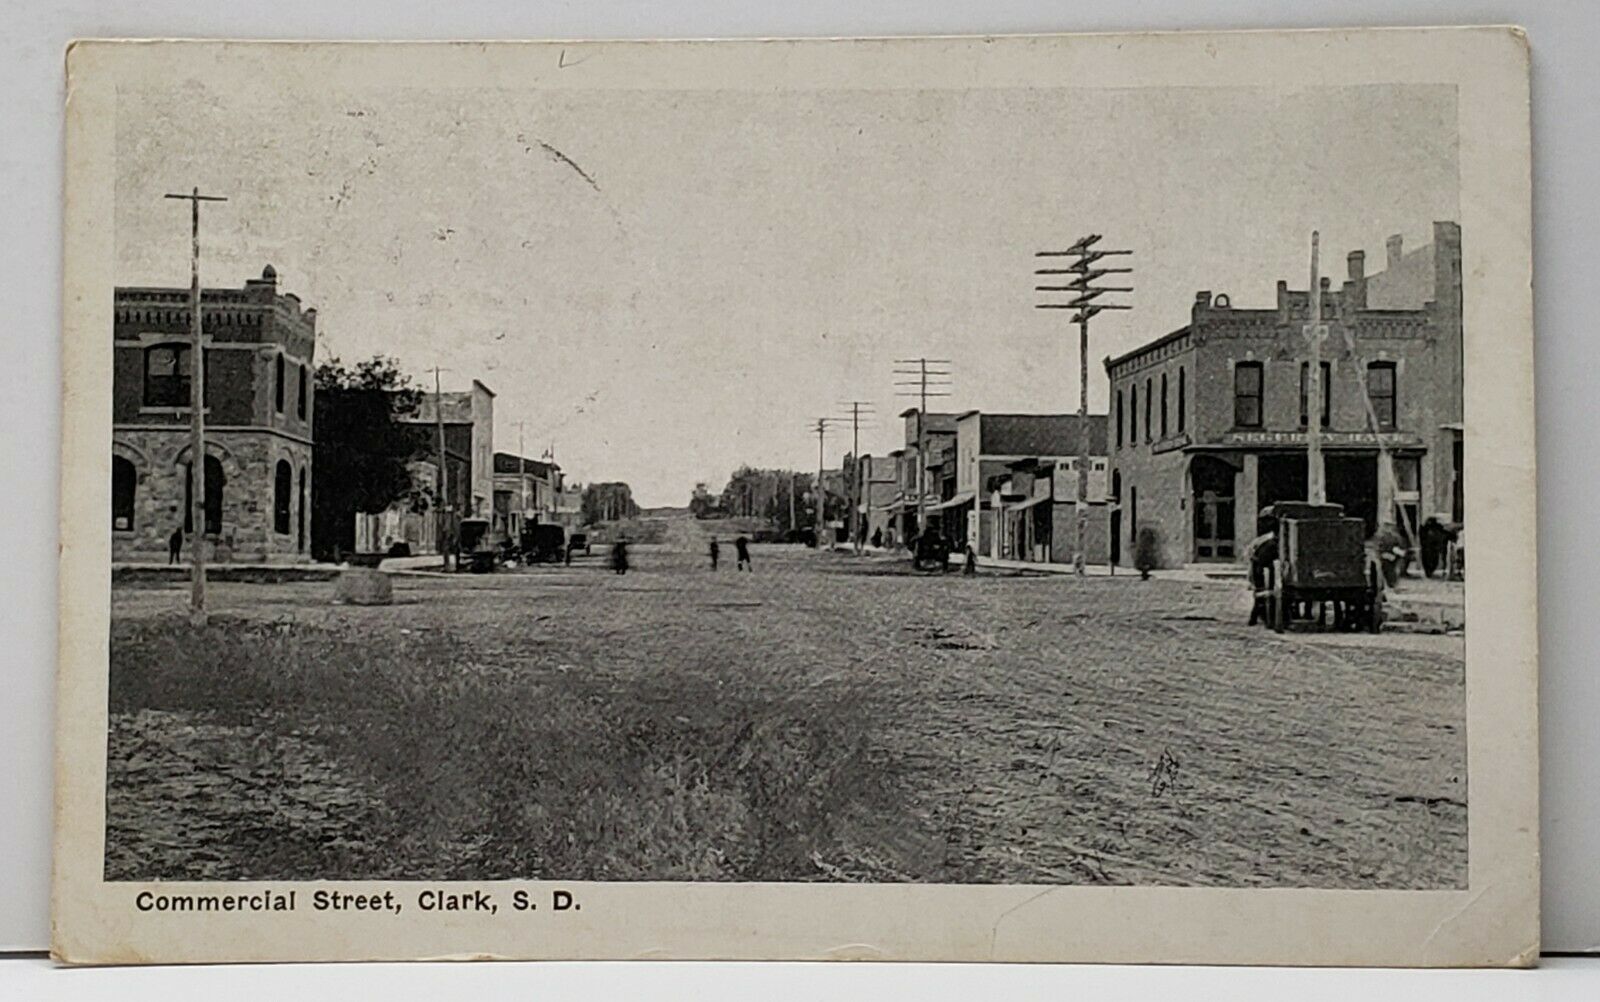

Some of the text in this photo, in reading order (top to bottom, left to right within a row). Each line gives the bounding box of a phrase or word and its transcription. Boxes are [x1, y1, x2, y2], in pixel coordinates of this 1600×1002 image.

[135, 890, 581, 915] Commercial Street, Clark, S. D.
